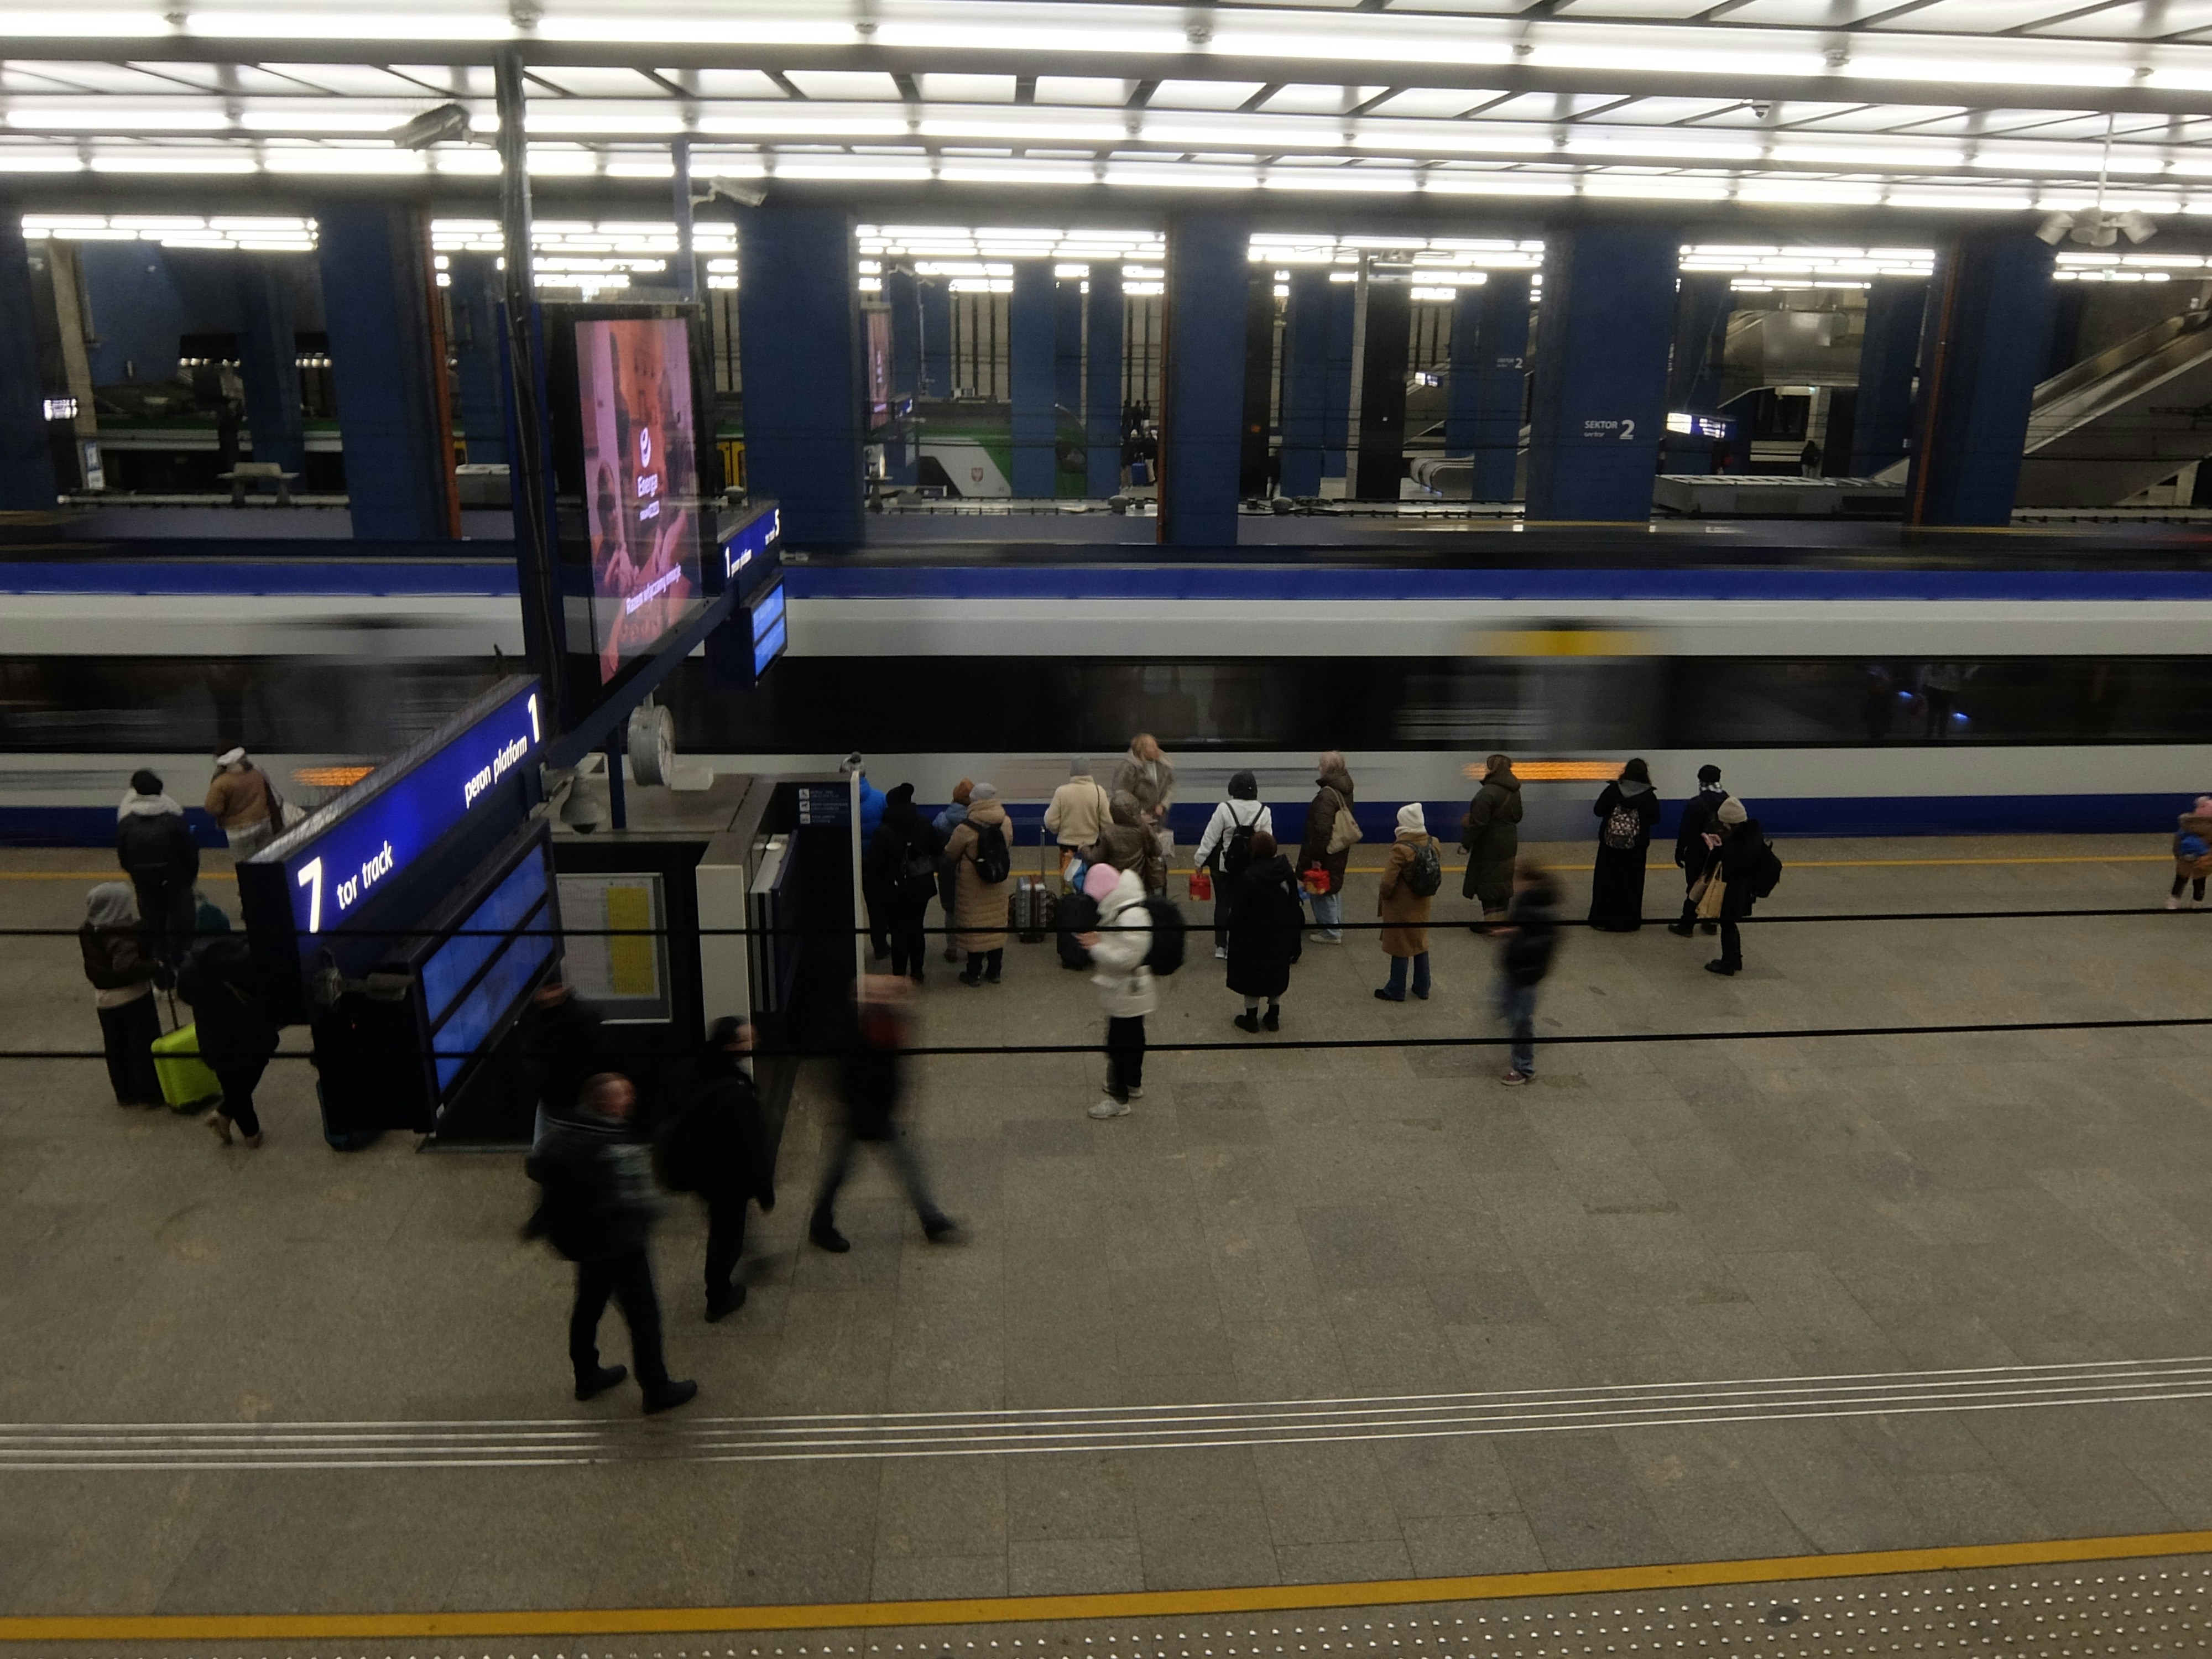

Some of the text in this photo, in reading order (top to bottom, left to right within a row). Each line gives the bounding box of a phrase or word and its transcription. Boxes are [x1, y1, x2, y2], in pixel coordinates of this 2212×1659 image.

[1515, 357, 1523, 369] 2
[1584, 419, 1635, 440] SEKTOR 2
[774, 508, 780, 538] 5
[725, 546, 731, 578] 1
[464, 693, 540, 810] peron platform 1
[298, 839, 393, 933] 7 tor track
